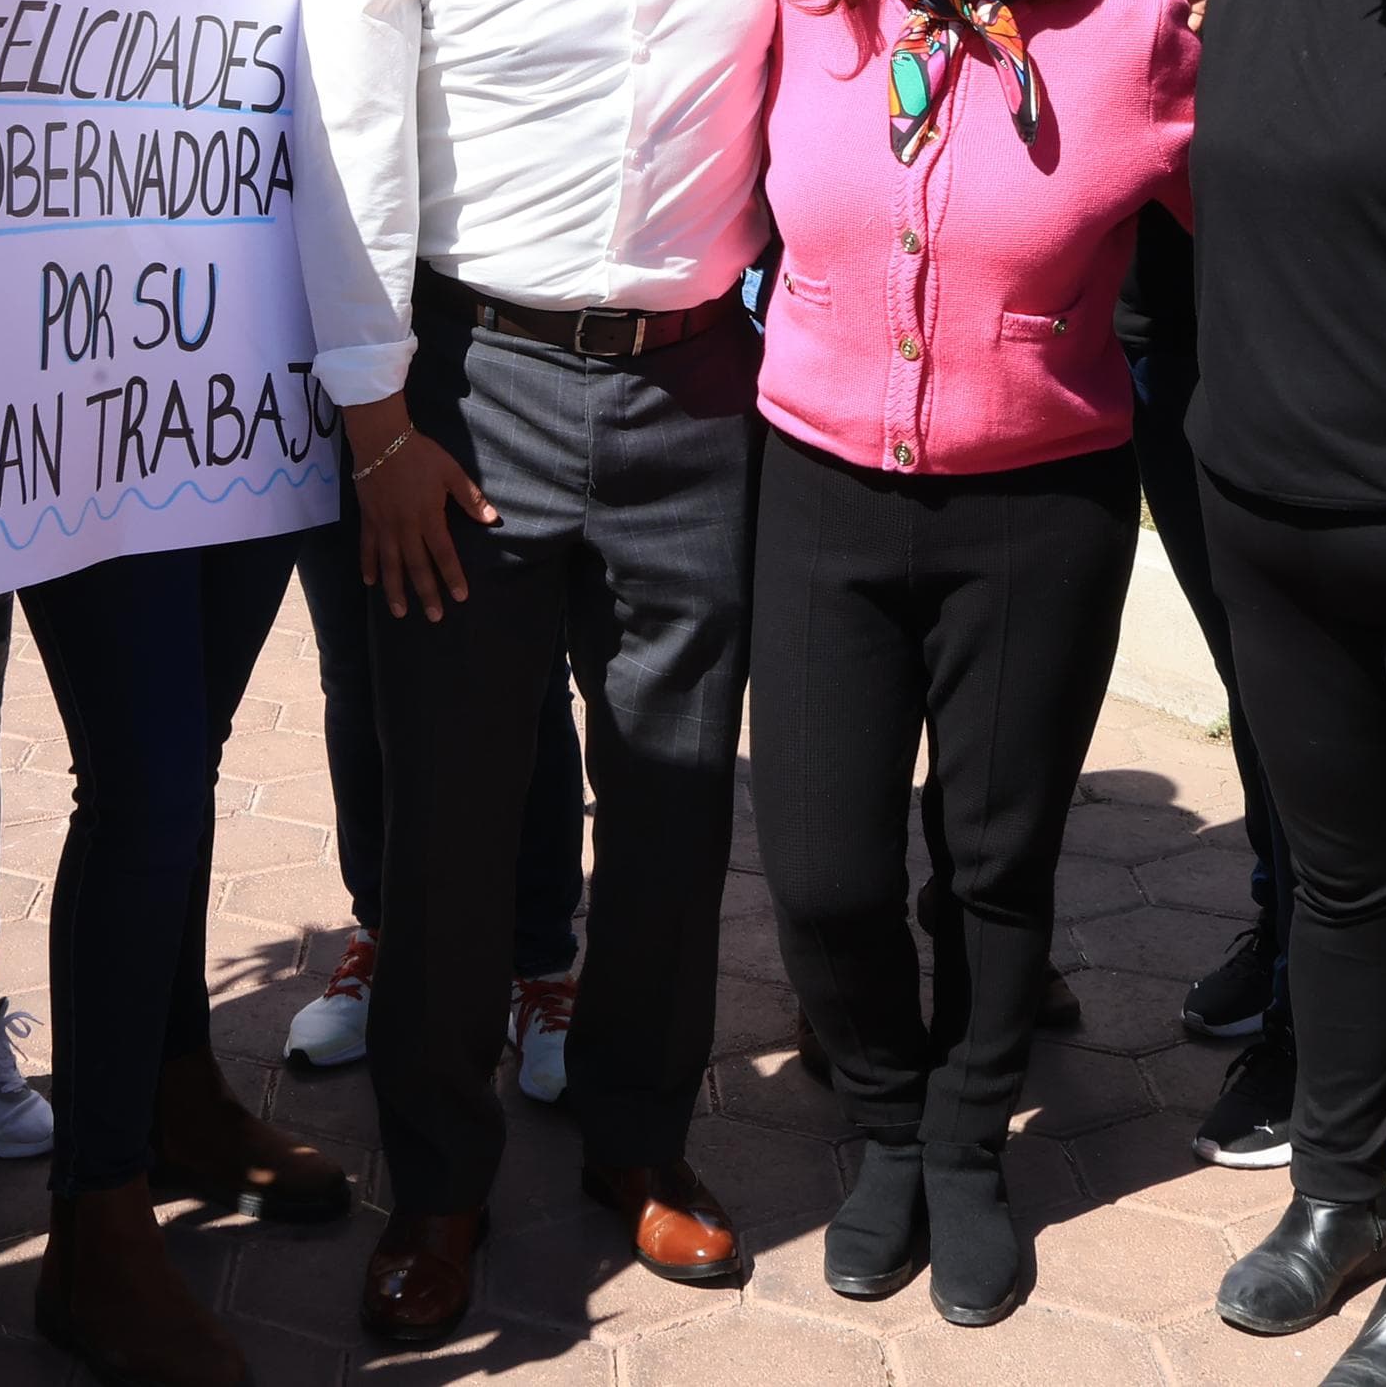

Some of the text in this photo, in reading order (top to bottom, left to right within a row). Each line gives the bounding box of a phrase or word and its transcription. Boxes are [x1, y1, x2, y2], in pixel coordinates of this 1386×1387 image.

[40, 261, 219, 371] POR SU
[86, 362, 339, 492] TRABAJO
